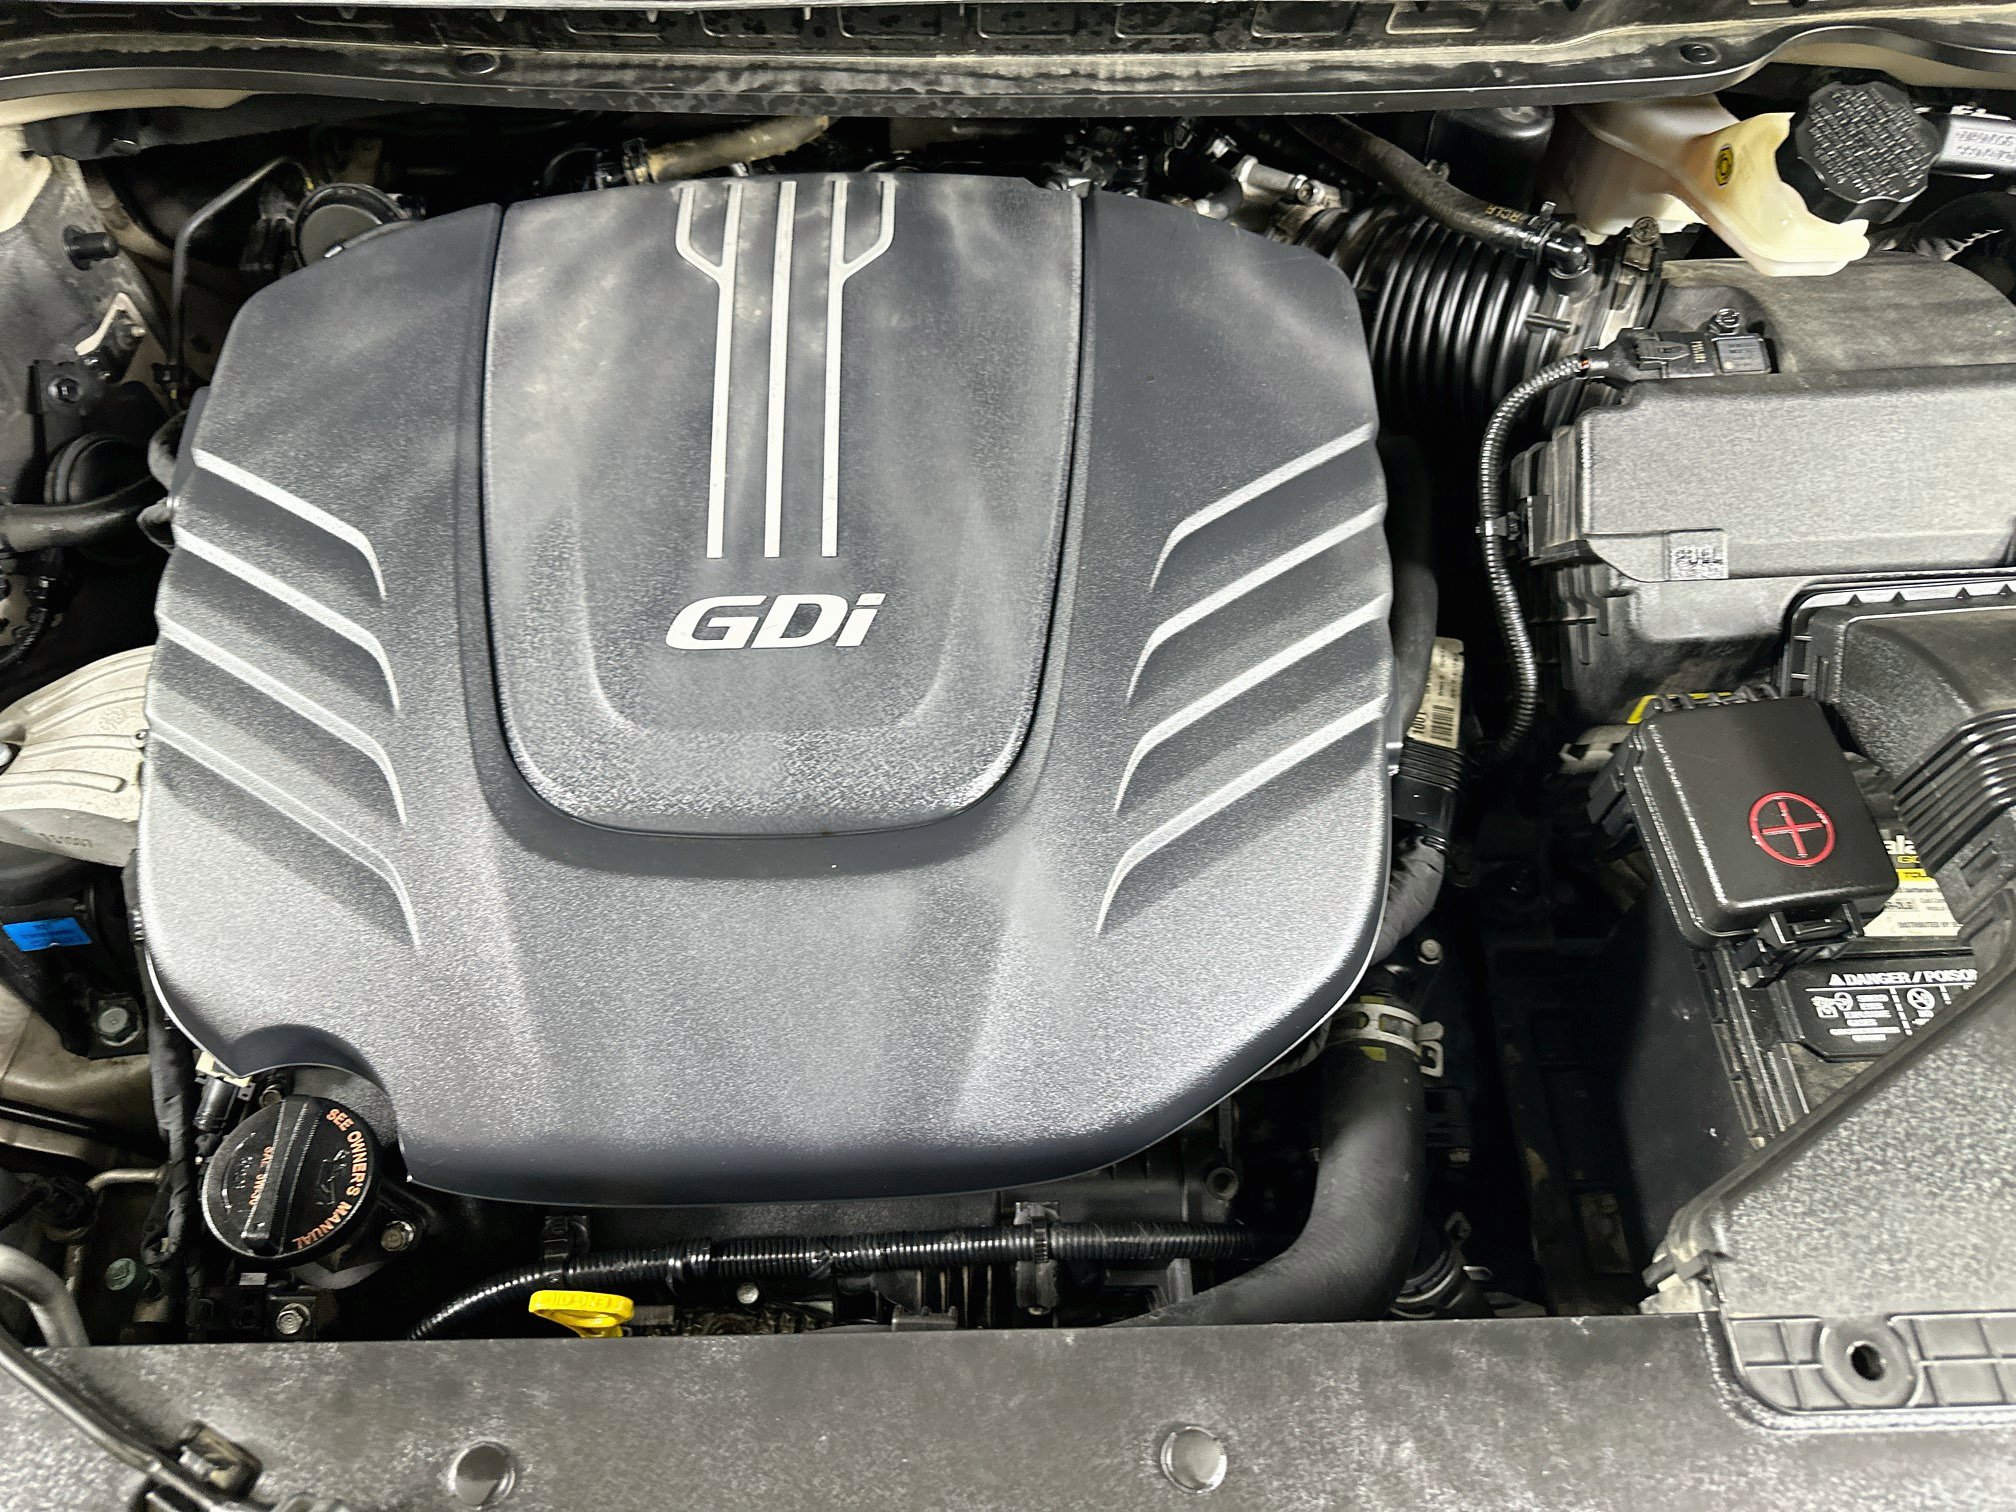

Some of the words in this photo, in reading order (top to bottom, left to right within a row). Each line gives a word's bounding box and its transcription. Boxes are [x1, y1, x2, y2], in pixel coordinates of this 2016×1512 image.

[665, 592, 887, 650] GDi
[1842, 971, 1911, 986] DANGER
[326, 1108, 355, 1132] SEE
[346, 1130, 368, 1197] OWNER'S
[291, 1201, 352, 1250] MANUAL
